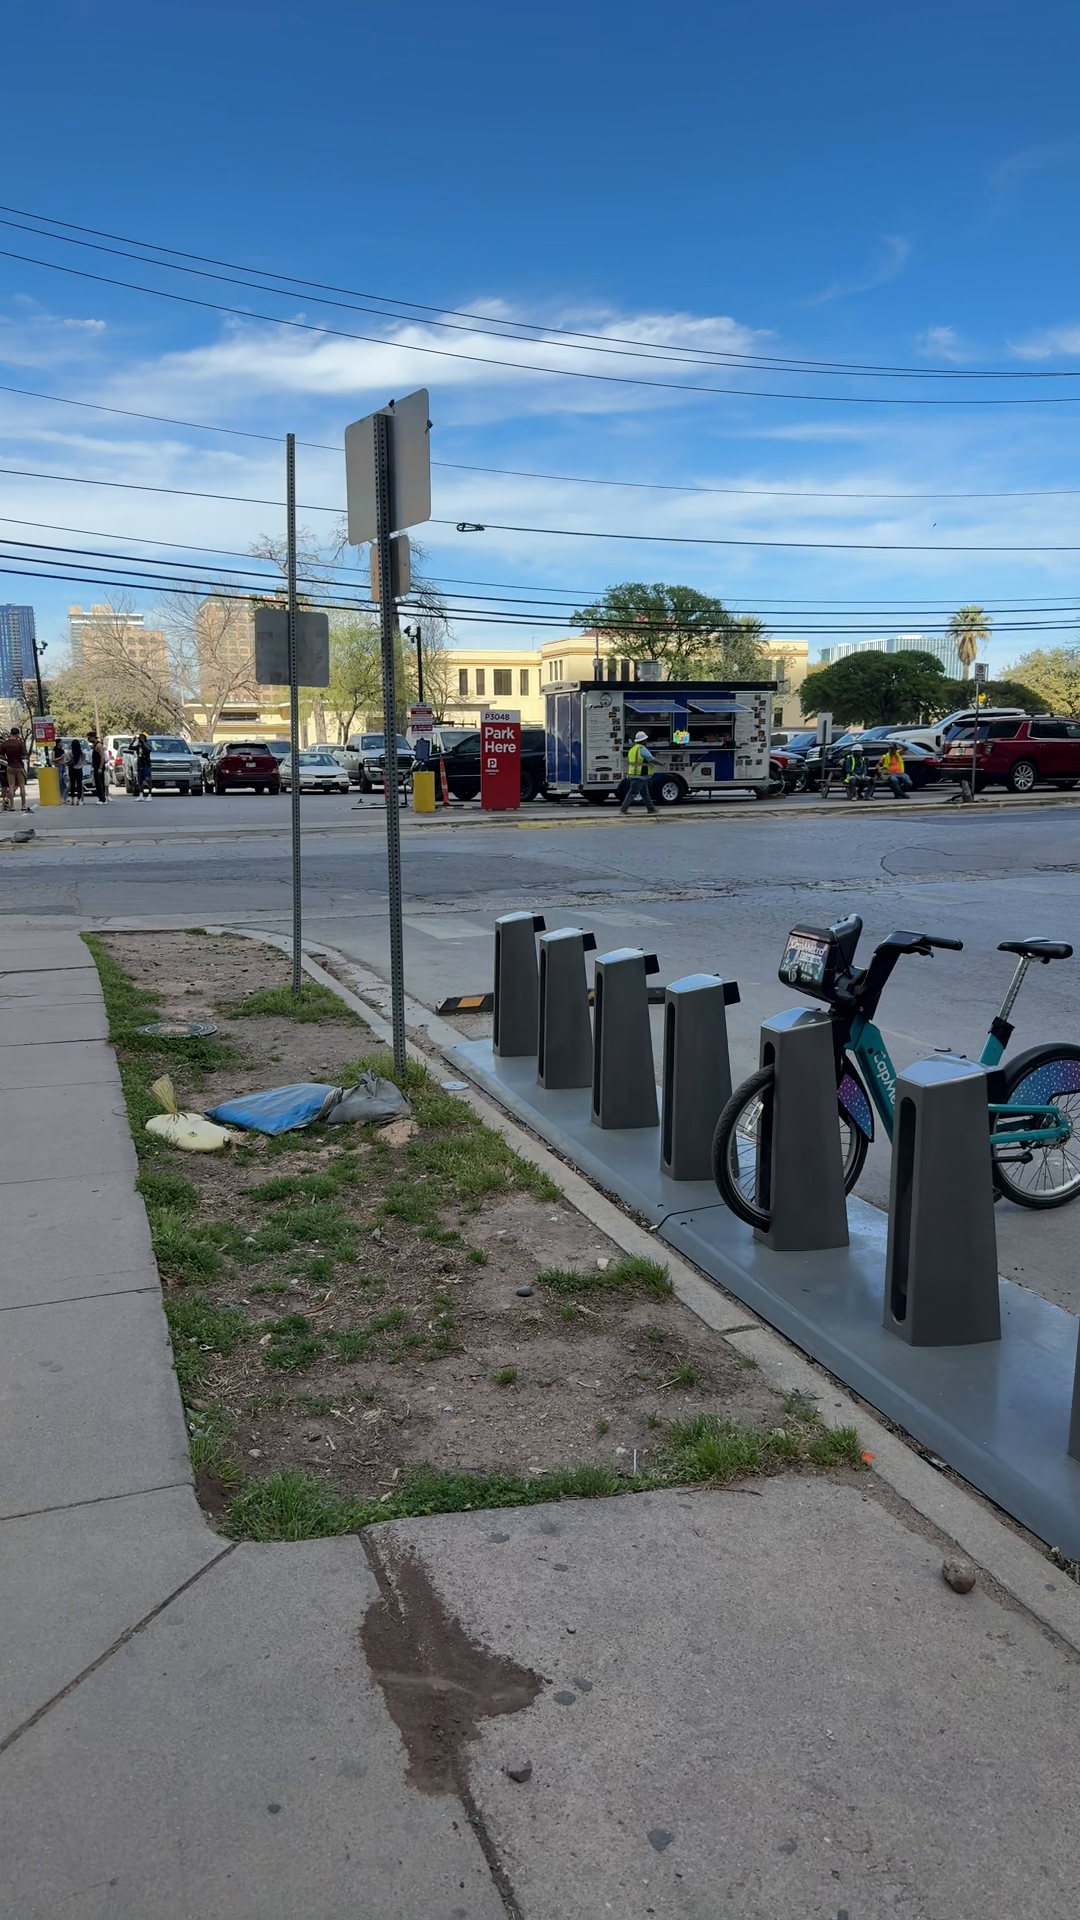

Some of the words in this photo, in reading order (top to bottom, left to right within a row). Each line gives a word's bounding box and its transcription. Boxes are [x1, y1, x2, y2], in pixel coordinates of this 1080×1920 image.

[485, 713, 510, 721] P3048
[484, 726, 515, 739] Park
[485, 741, 517, 753] Here
